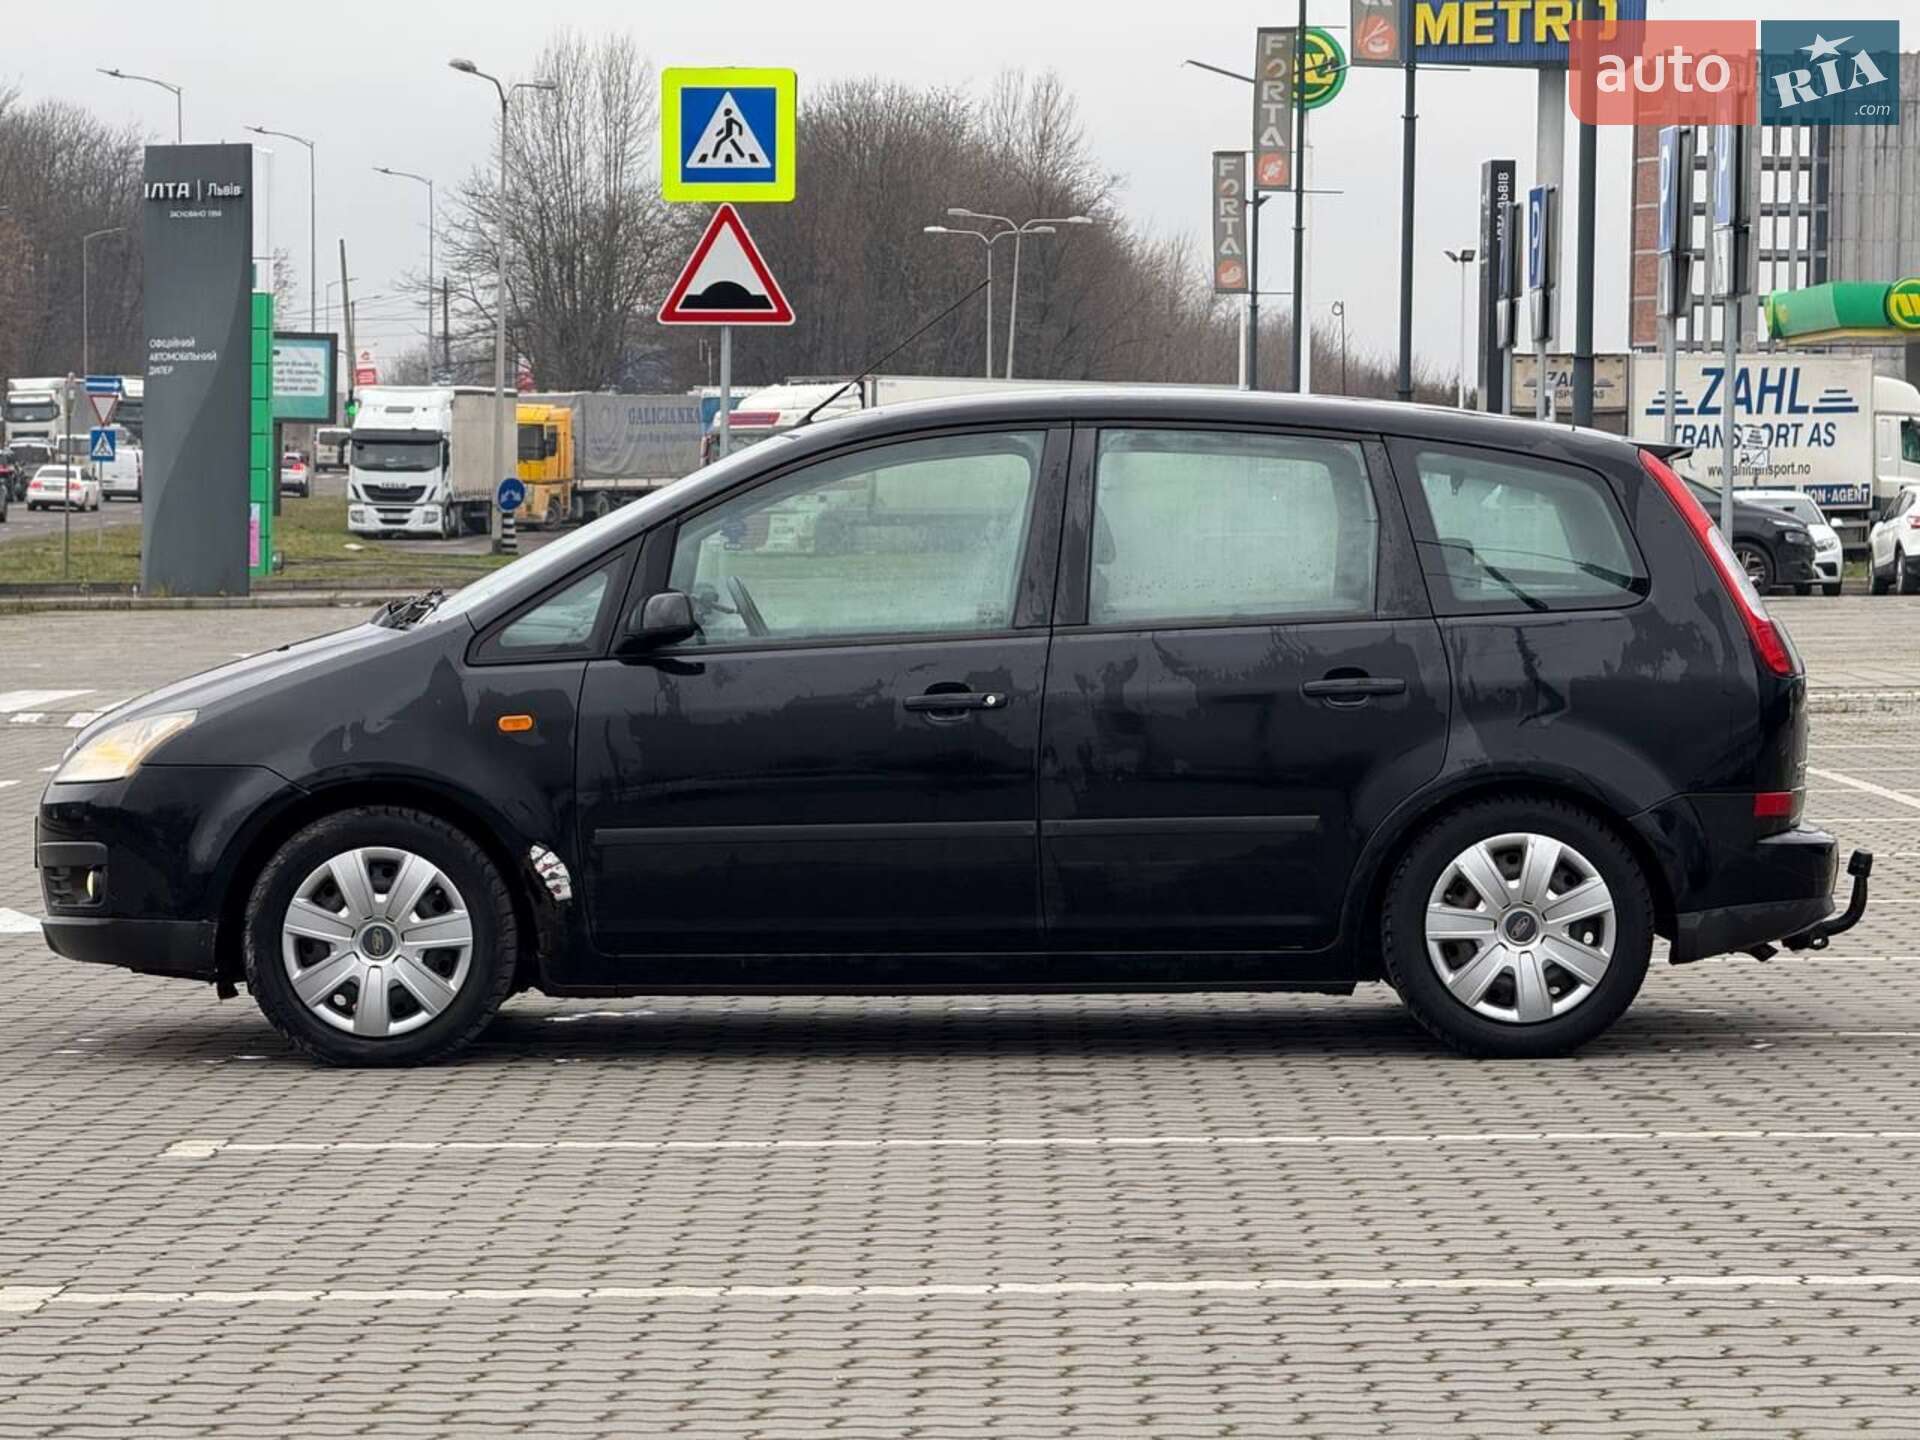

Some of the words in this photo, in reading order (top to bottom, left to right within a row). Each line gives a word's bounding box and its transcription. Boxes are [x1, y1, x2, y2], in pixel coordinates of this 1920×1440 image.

[1259, 35, 1286, 147] FORTA
[207, 182, 241, 196] Львів
[1219, 158, 1241, 255] FORTA
[1697, 367, 1809, 416] ZAHL
[1807, 422, 1837, 447] AS
